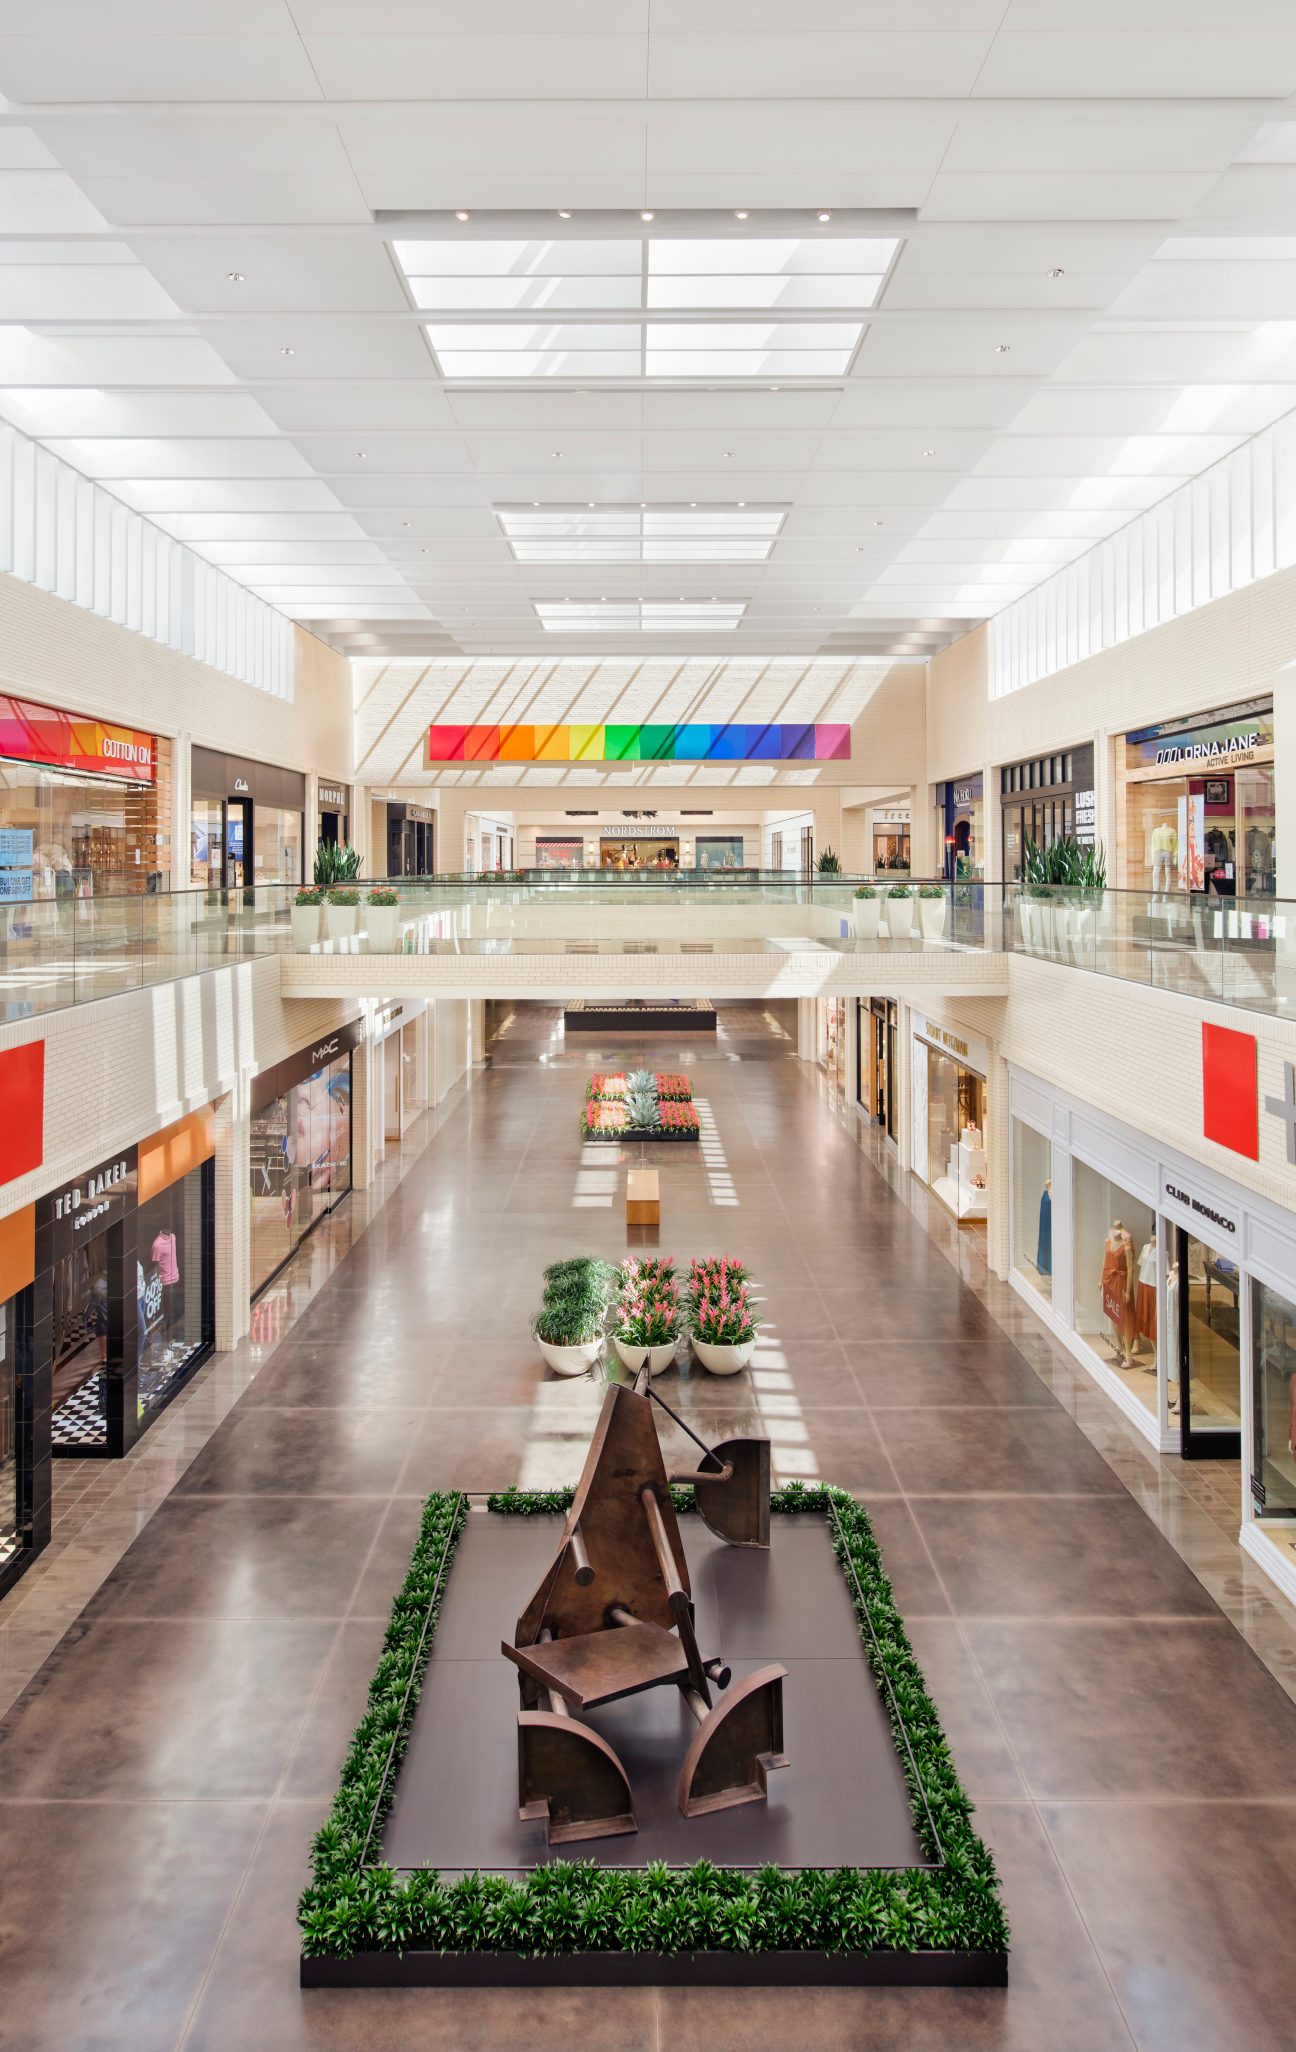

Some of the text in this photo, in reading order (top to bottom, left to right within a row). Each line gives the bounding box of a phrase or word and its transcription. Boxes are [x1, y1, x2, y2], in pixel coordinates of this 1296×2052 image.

[103, 738, 151, 765] COTTON ON
[1178, 732, 1259, 761] LORNA JANE
[1206, 751, 1254, 768] ACTIVE LIVING
[319, 787, 345, 805] MORPHE
[603, 826, 675, 836] NORDSTROM
[55, 1161, 127, 1219] TED BAKER
[1166, 1184, 1236, 1233] CLUB MONACO
[145, 1275, 163, 1304] 60%
[146, 1292, 162, 1319] OFF
[1105, 1294, 1121, 1318] SALE
